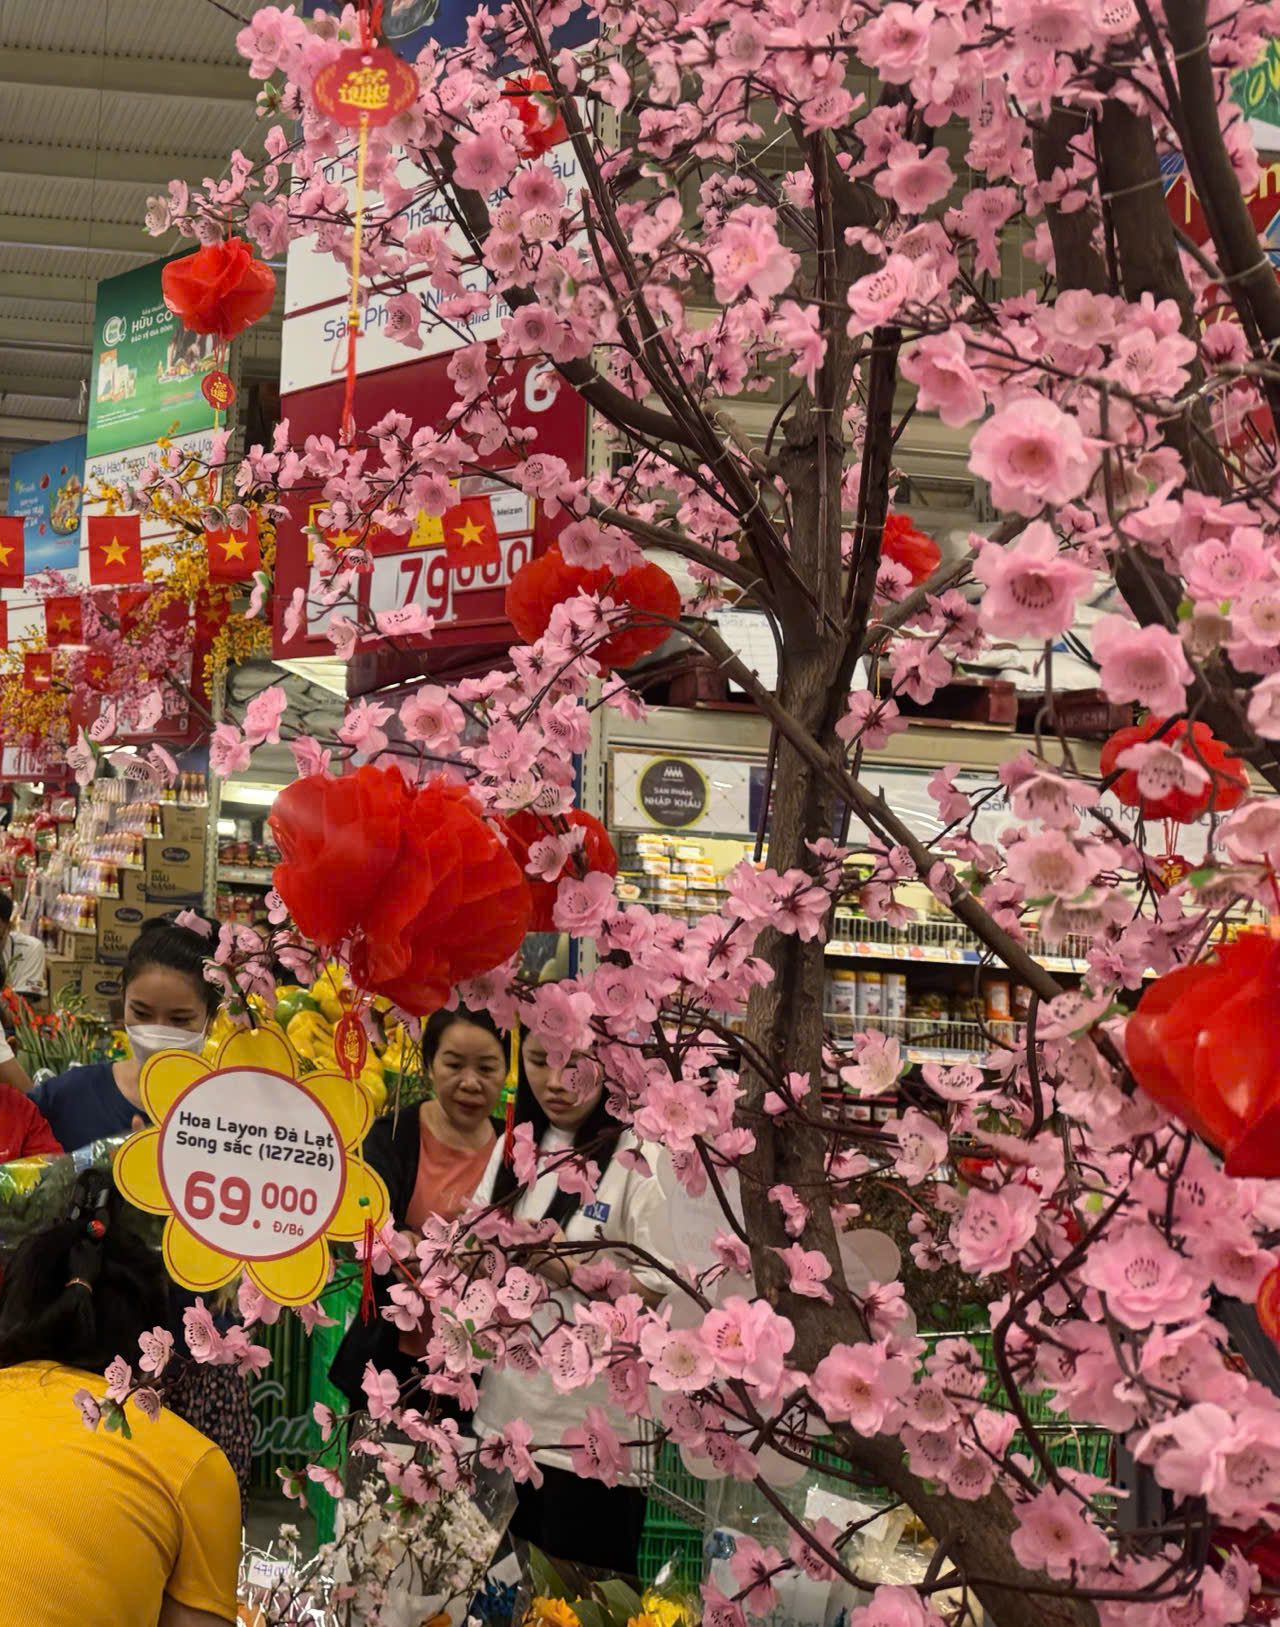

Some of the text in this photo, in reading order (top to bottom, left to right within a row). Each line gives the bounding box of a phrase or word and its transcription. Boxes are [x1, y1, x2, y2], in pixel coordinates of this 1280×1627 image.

[497, 505, 523, 517] Meizan
[179, 1111, 211, 1129] Hoa
[217, 1117, 267, 1139] Layon
[304, 1130, 334, 1150] Lạt
[176, 1131, 334, 1172] Song sắc (127228)
